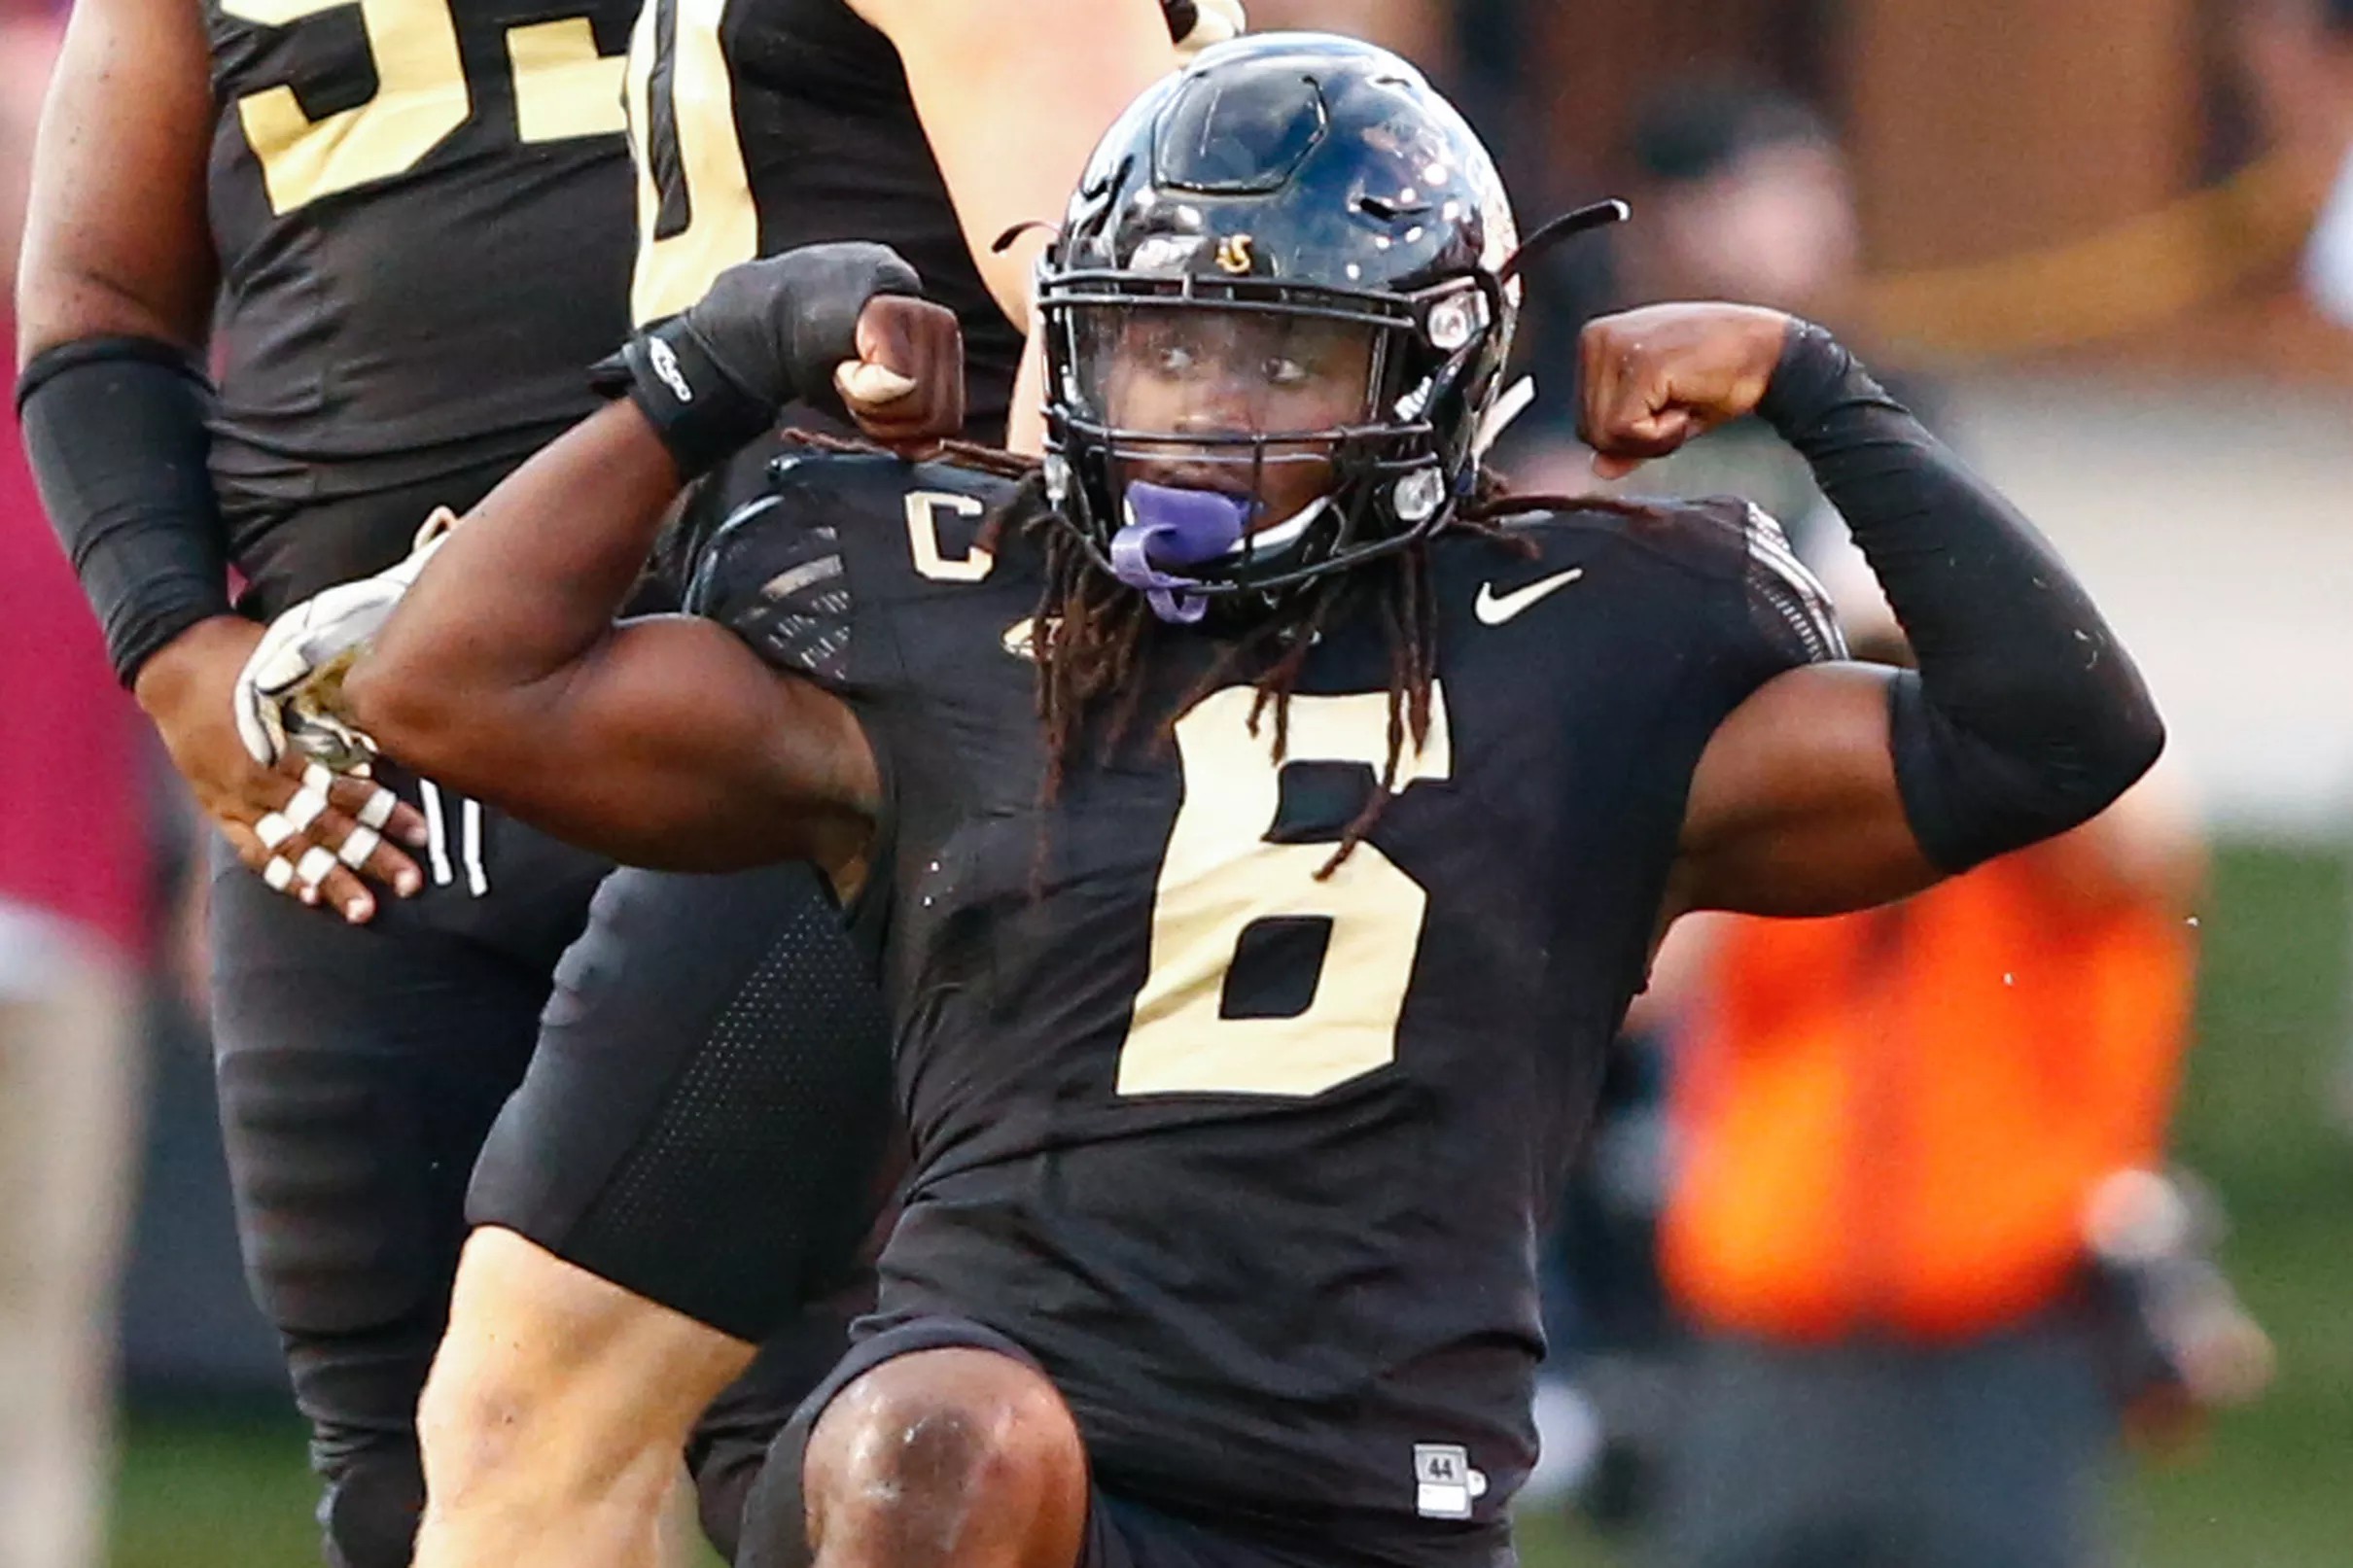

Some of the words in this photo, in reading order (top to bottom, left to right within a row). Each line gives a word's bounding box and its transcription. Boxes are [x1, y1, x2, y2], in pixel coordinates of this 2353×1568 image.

[905, 491, 993, 581] C
[1116, 679, 1454, 1098] 6
[1428, 1458, 1453, 1480] 44
